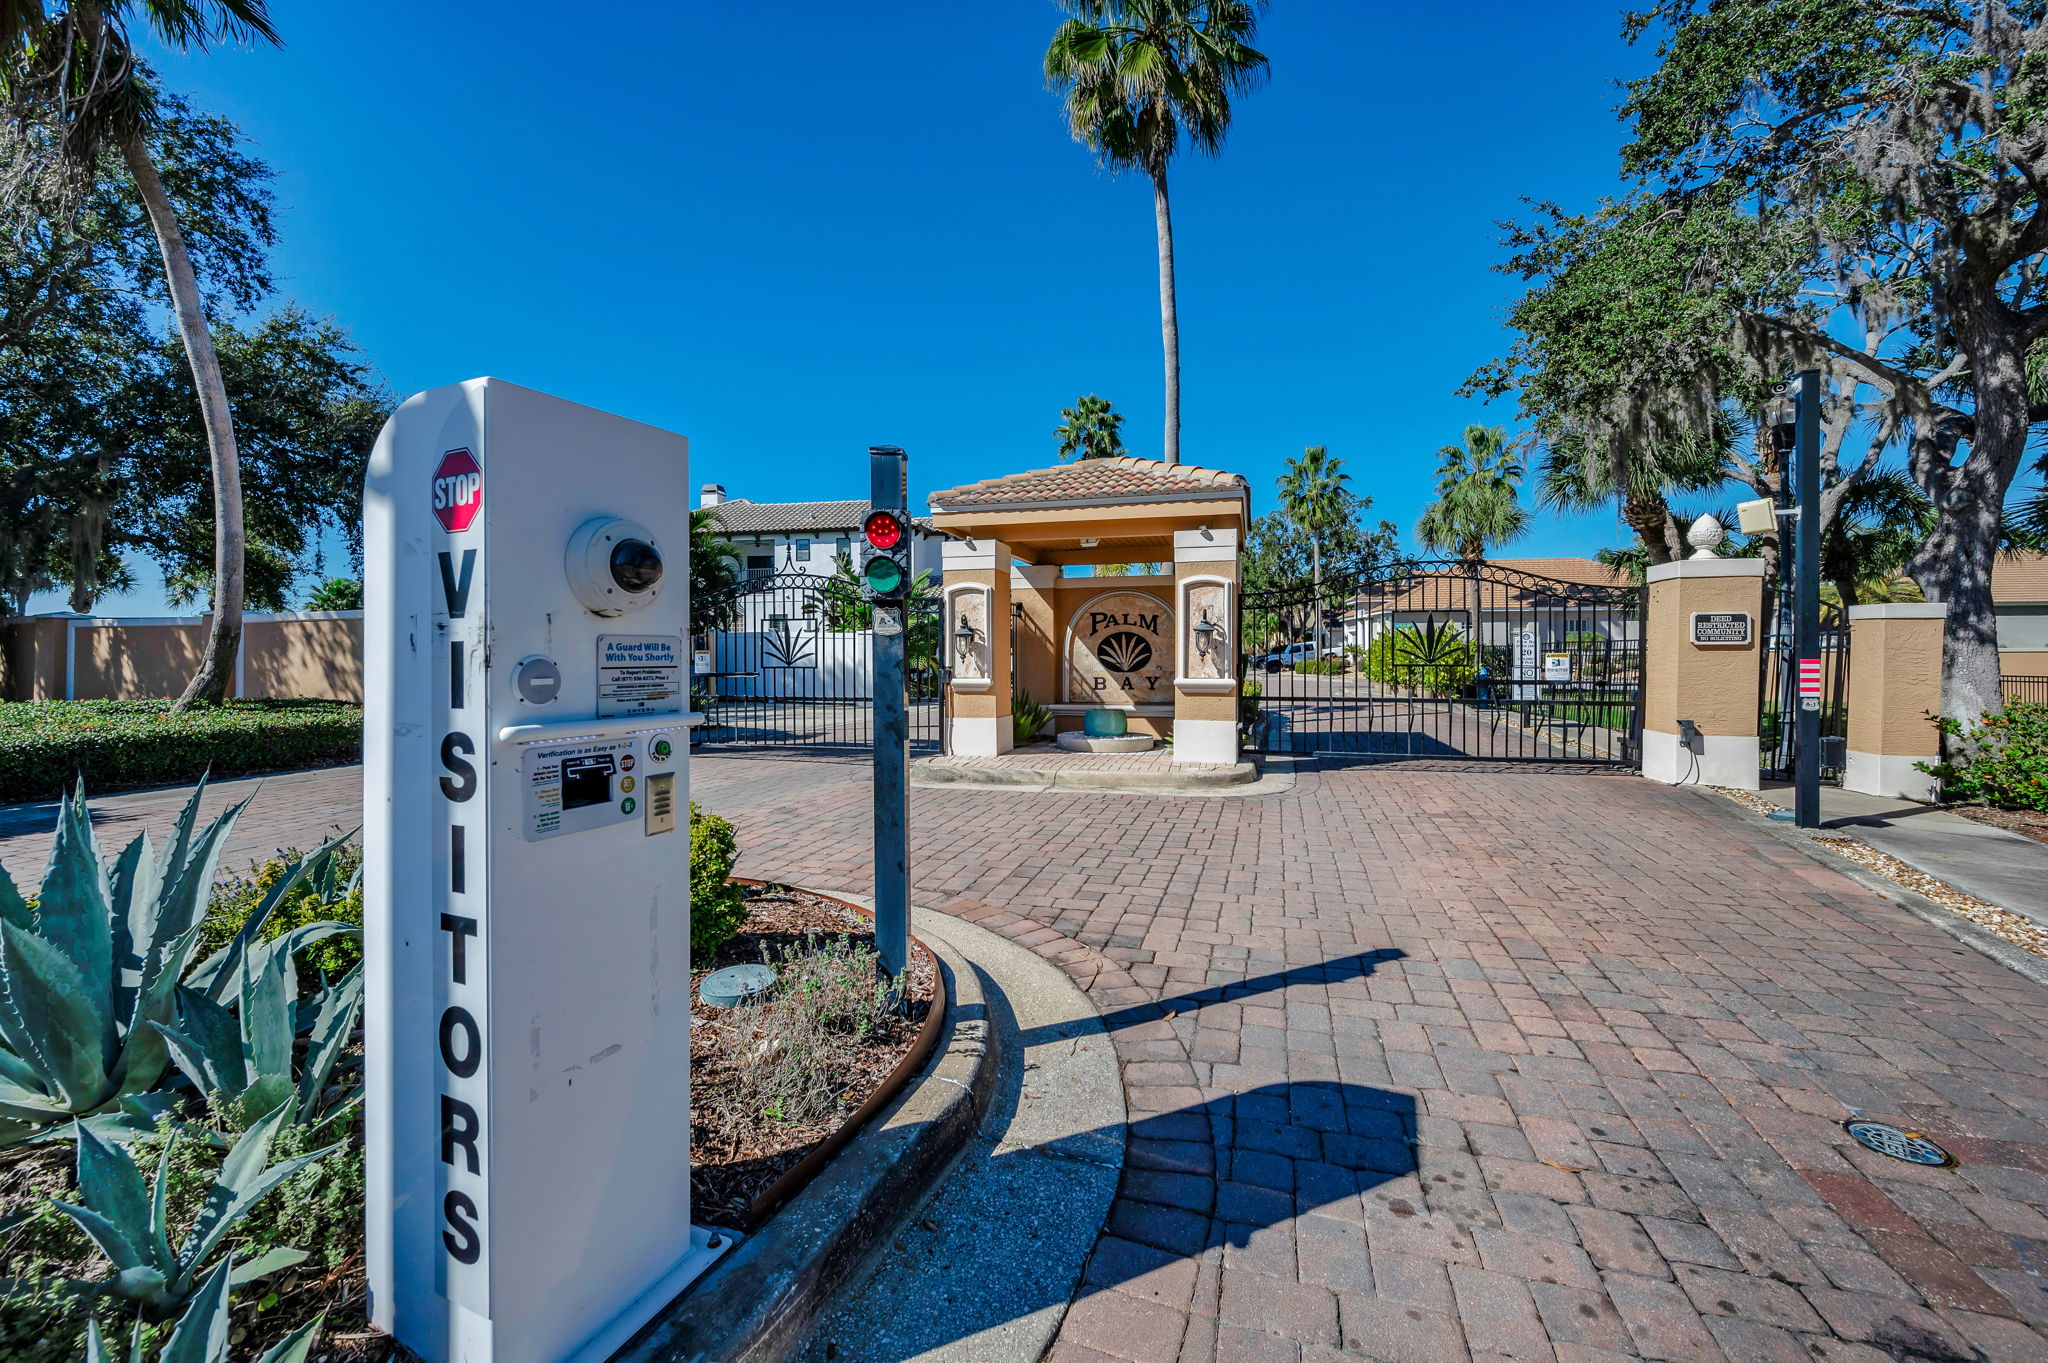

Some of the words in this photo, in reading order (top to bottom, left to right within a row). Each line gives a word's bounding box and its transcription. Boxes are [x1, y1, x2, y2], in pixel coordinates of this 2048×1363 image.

[434, 471, 481, 510] STOP
[1089, 612, 1160, 637] PALM
[1697, 621, 1746, 629] RESTRICTED
[607, 642, 614, 651] A
[615, 642, 642, 652] Guard
[644, 642, 660, 652] Will
[660, 643, 671, 652] Be
[605, 653, 626, 662] With
[627, 653, 643, 662] You
[644, 653, 675, 663] Shortly
[1093, 676, 1161, 691] BAY
[537, 749, 576, 759] Verification
[592, 745, 607, 753] Easy
[621, 758, 635, 768] STOP
[437, 548, 482, 1265] VISITORS
